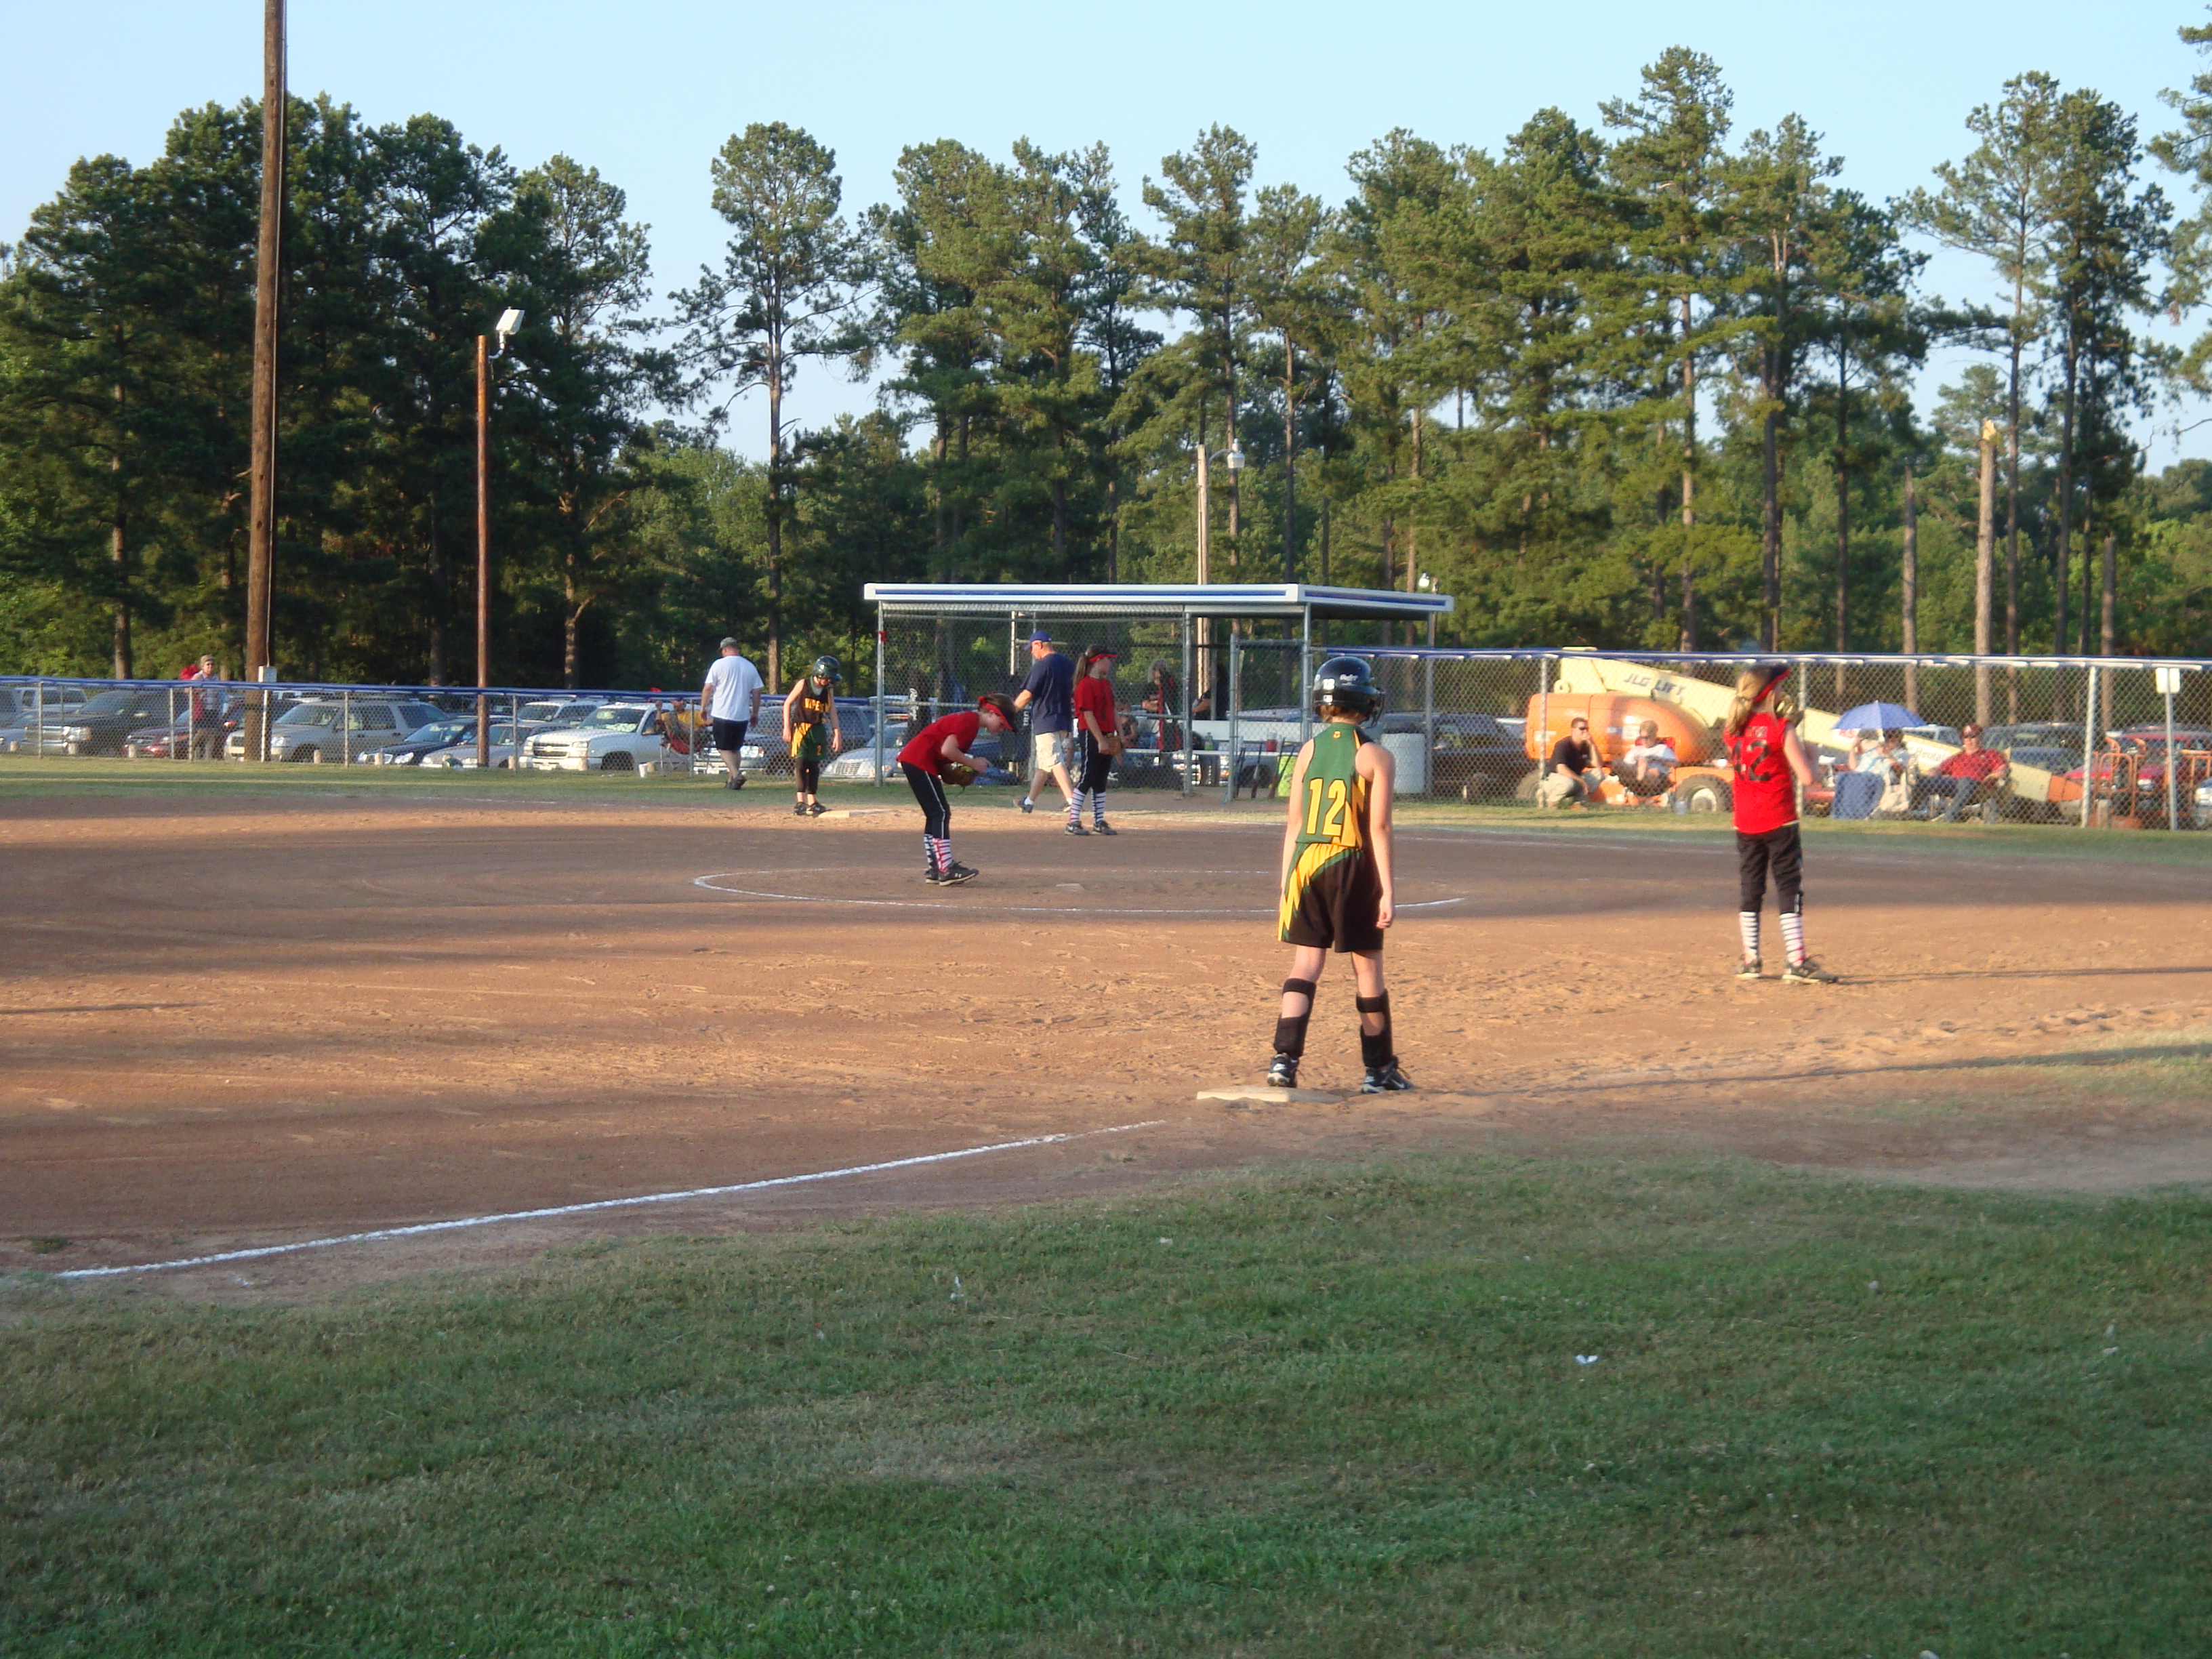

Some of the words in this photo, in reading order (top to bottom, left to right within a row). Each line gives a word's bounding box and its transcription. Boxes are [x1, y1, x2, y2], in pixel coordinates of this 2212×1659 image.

[1624, 673, 1651, 687] JLG
[1654, 680, 1687, 695] LIFT
[1307, 778, 1346, 836] 12
